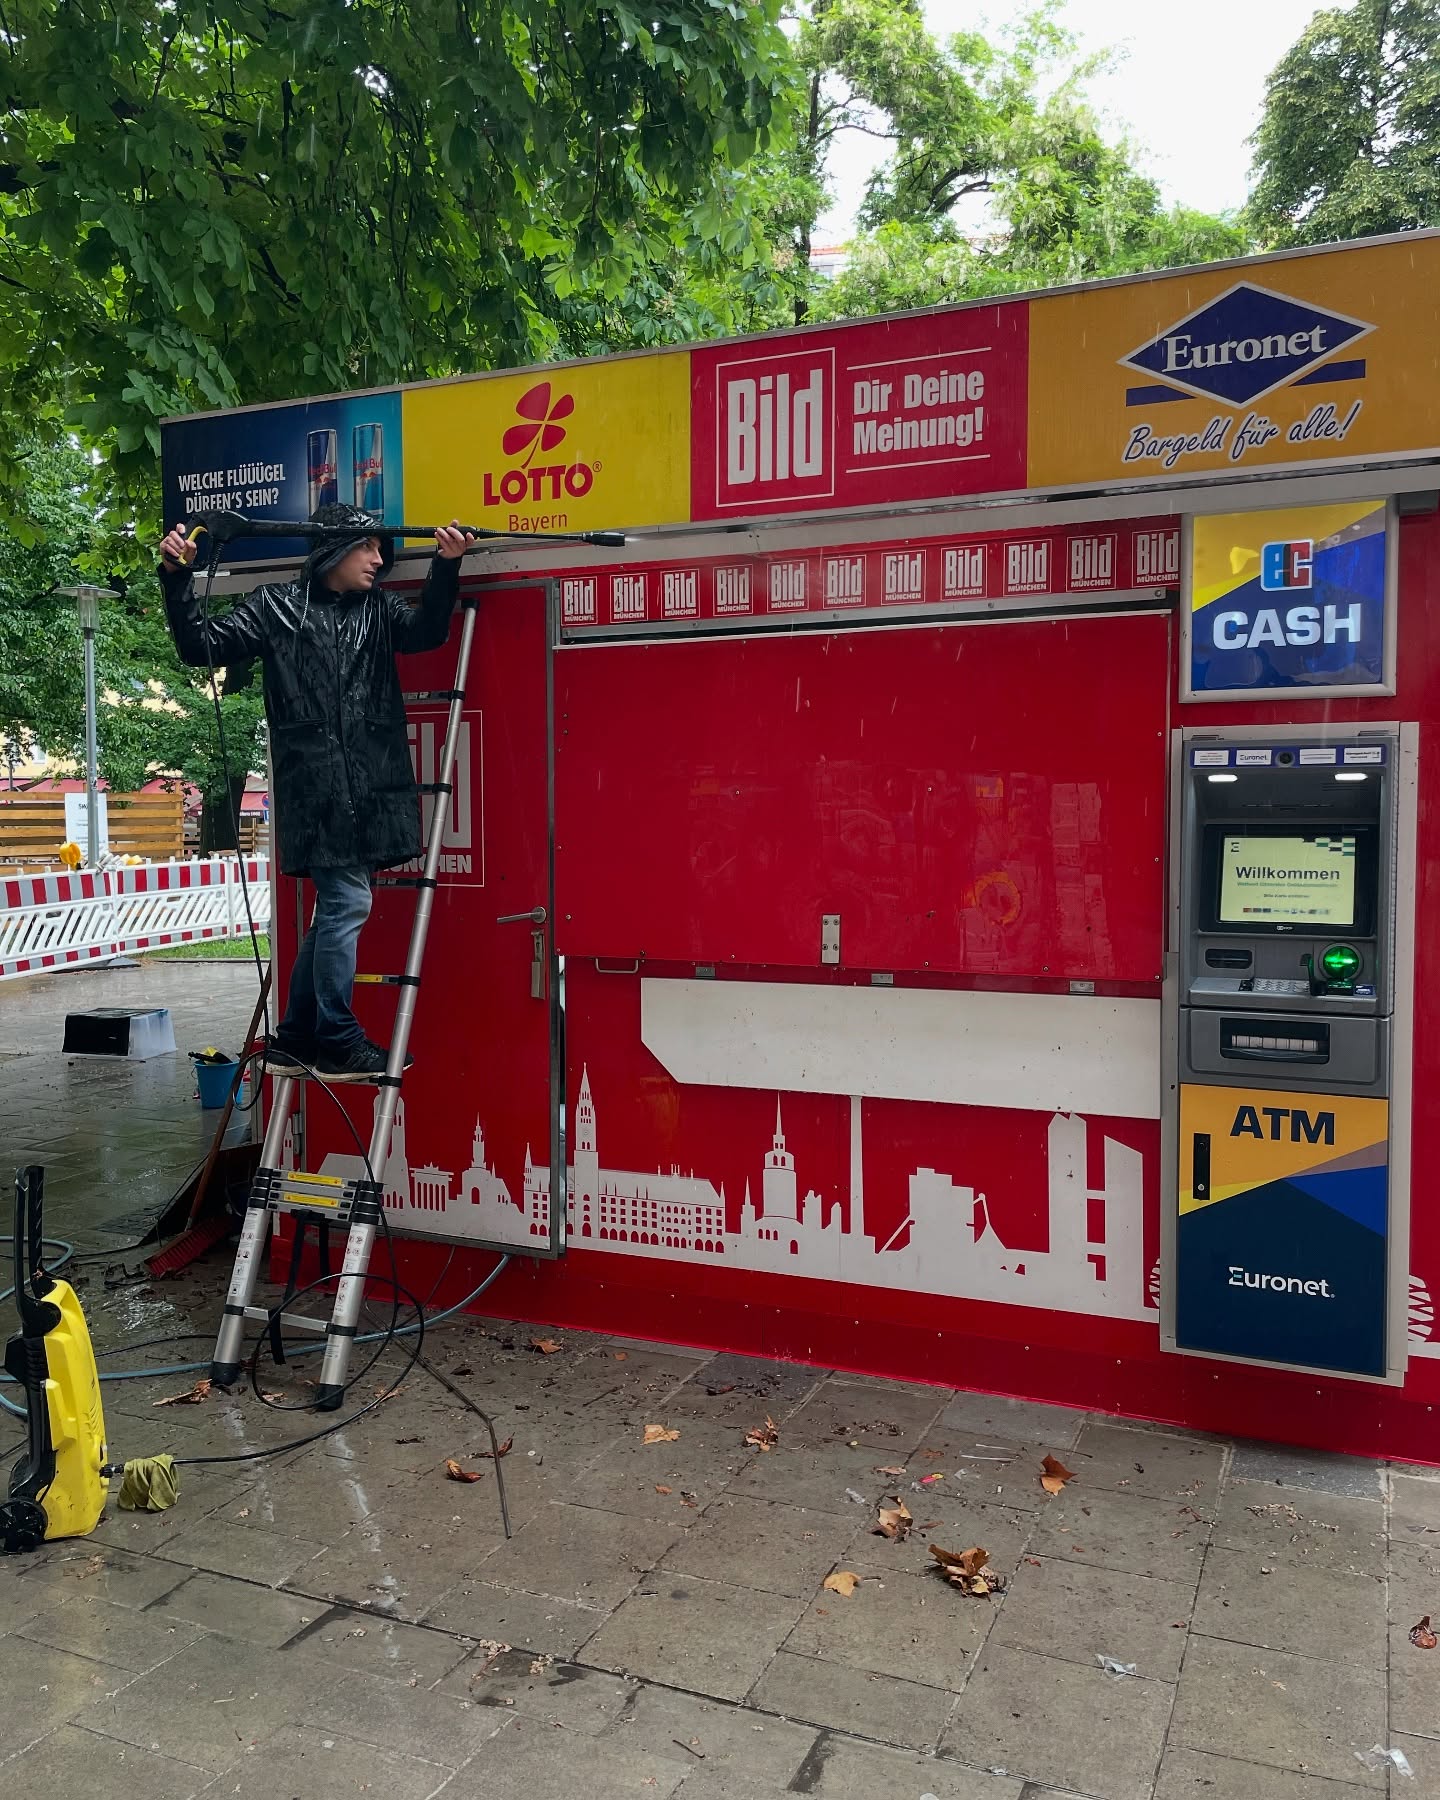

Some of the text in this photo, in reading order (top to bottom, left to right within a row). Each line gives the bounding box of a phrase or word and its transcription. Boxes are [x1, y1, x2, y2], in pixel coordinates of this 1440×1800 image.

[1162, 324, 1327, 373] Euronet
[853, 369, 985, 415] Dir Deine
[727, 368, 823, 485] Bild
[853, 406, 984, 455] Meinung!
[1122, 399, 1363, 469] Bargeld für alle!
[178, 461, 286, 492] WELCHE FLÜÜÜGEL
[246, 487, 279, 508] SEIN?
[508, 513, 567, 533] Bayern
[945, 548, 983, 589] Bild
[1008, 543, 1047, 584] Bild
[1071, 538, 1112, 579] Bild
[1137, 531, 1179, 575] Bild
[664, 571, 696, 609] Bild
[716, 567, 749, 605] Bild
[771, 562, 805, 601] Bild
[827, 558, 862, 598] Bild
[886, 553, 922, 593] Bild
[1007, 583, 1047, 592] MÜNCHEN
[1070, 578, 1112, 588] MÜNCHEN
[1136, 573, 1179, 583] MÜNCHEN
[564, 579, 594, 615] Bild
[613, 576, 644, 612] Bild
[717, 604, 750, 613] MÜNCHEN
[771, 600, 805, 609] MÜNCHEN
[827, 596, 862, 605] MÜNCHEN
[885, 592, 921, 601] MÜNCHEN
[944, 588, 983, 597] MÜNCHEN
[664, 609, 696, 617] MÜNCHEN
[1213, 603, 1362, 650] CASH
[1235, 866, 1340, 880] Willkommen
[1229, 1105, 1335, 1146] ATM
[1228, 1266, 1332, 1298] Euronet
